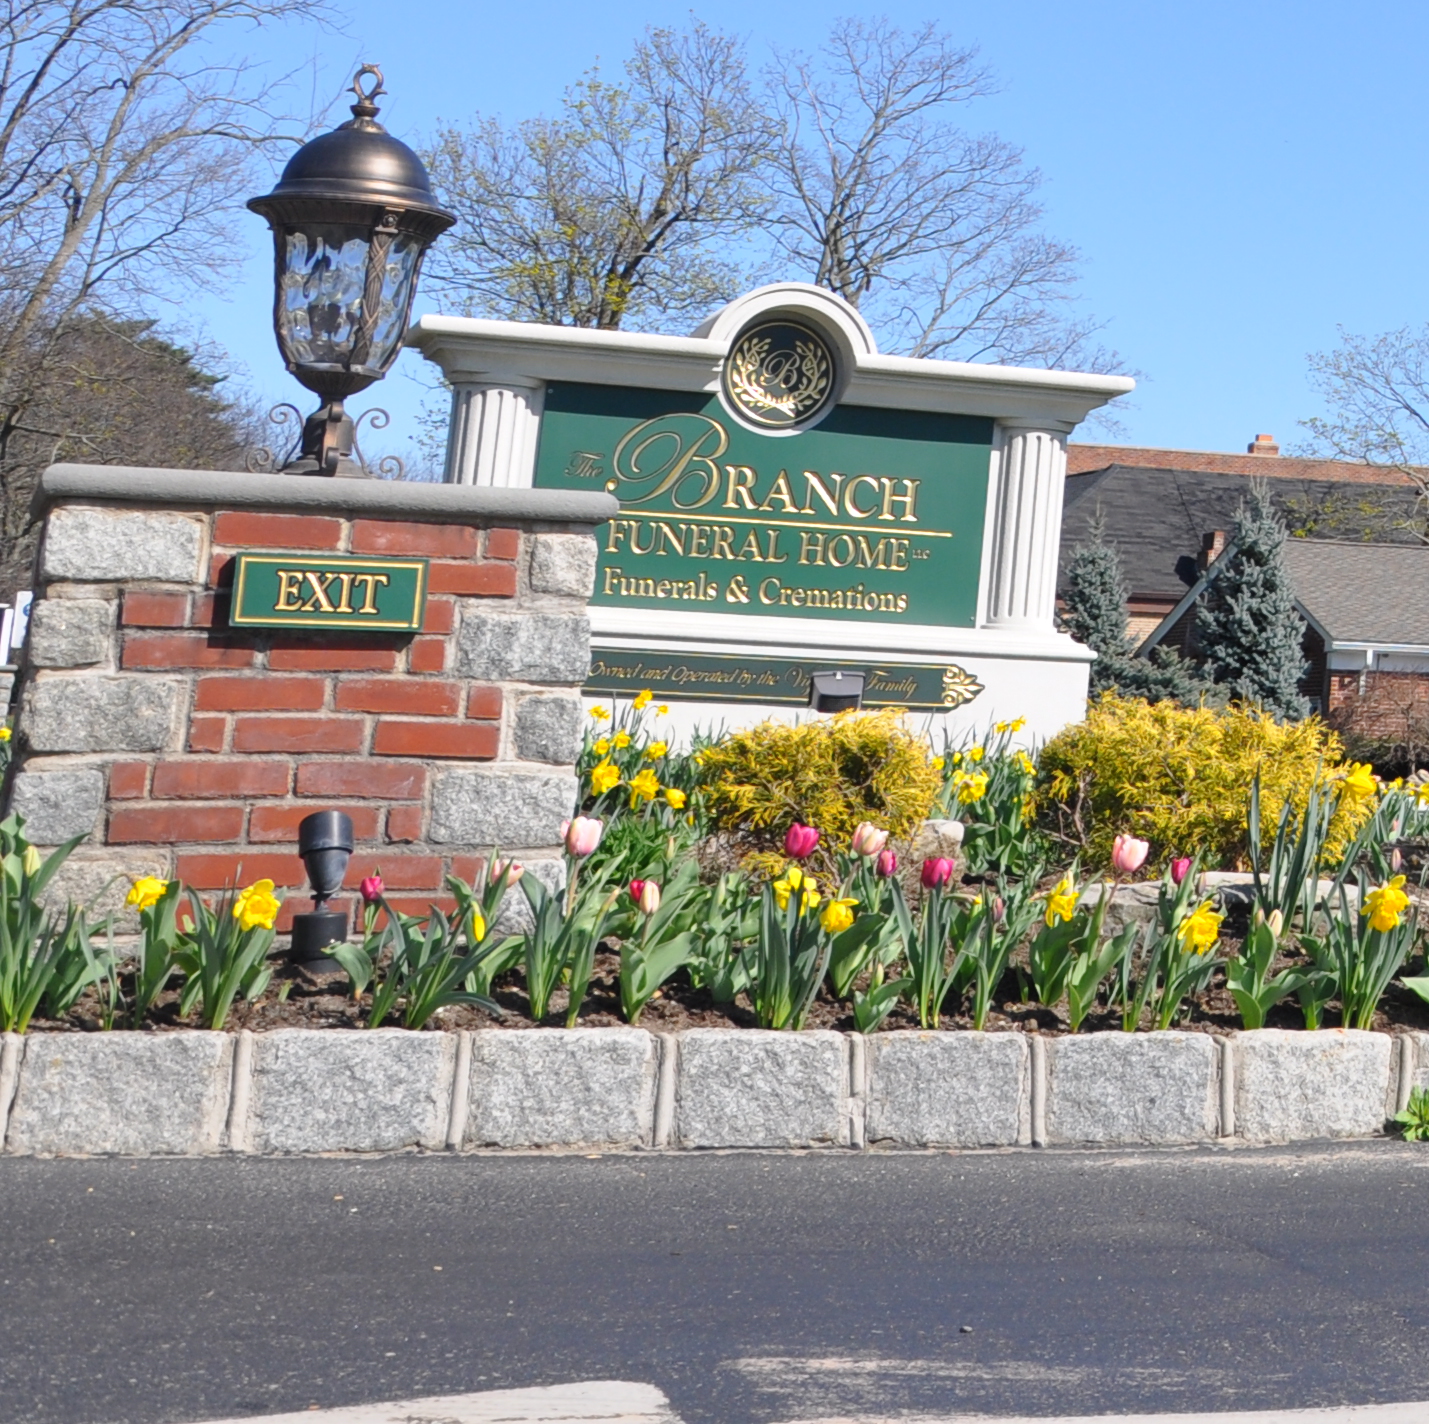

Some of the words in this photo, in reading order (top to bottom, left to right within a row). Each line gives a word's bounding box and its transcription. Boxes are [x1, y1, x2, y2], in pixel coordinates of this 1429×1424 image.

[760, 349, 801, 389] B
[564, 450, 605, 477] The
[605, 412, 921, 522] BRANCH
[605, 518, 788, 563] FUNERAL
[797, 531, 910, 571] HOME
[912, 549, 930, 560] LLC
[274, 568, 390, 614] EXIT
[602, 566, 718, 601] Funerals
[726, 574, 751, 604] &
[759, 577, 909, 613] Cremations
[588, 661, 642, 679] Owned
[640, 665, 672, 681] and
[671, 665, 738, 685] Operated
[737, 668, 756, 687] by
[756, 669, 780, 686] the
[864, 668, 918, 700] Family
